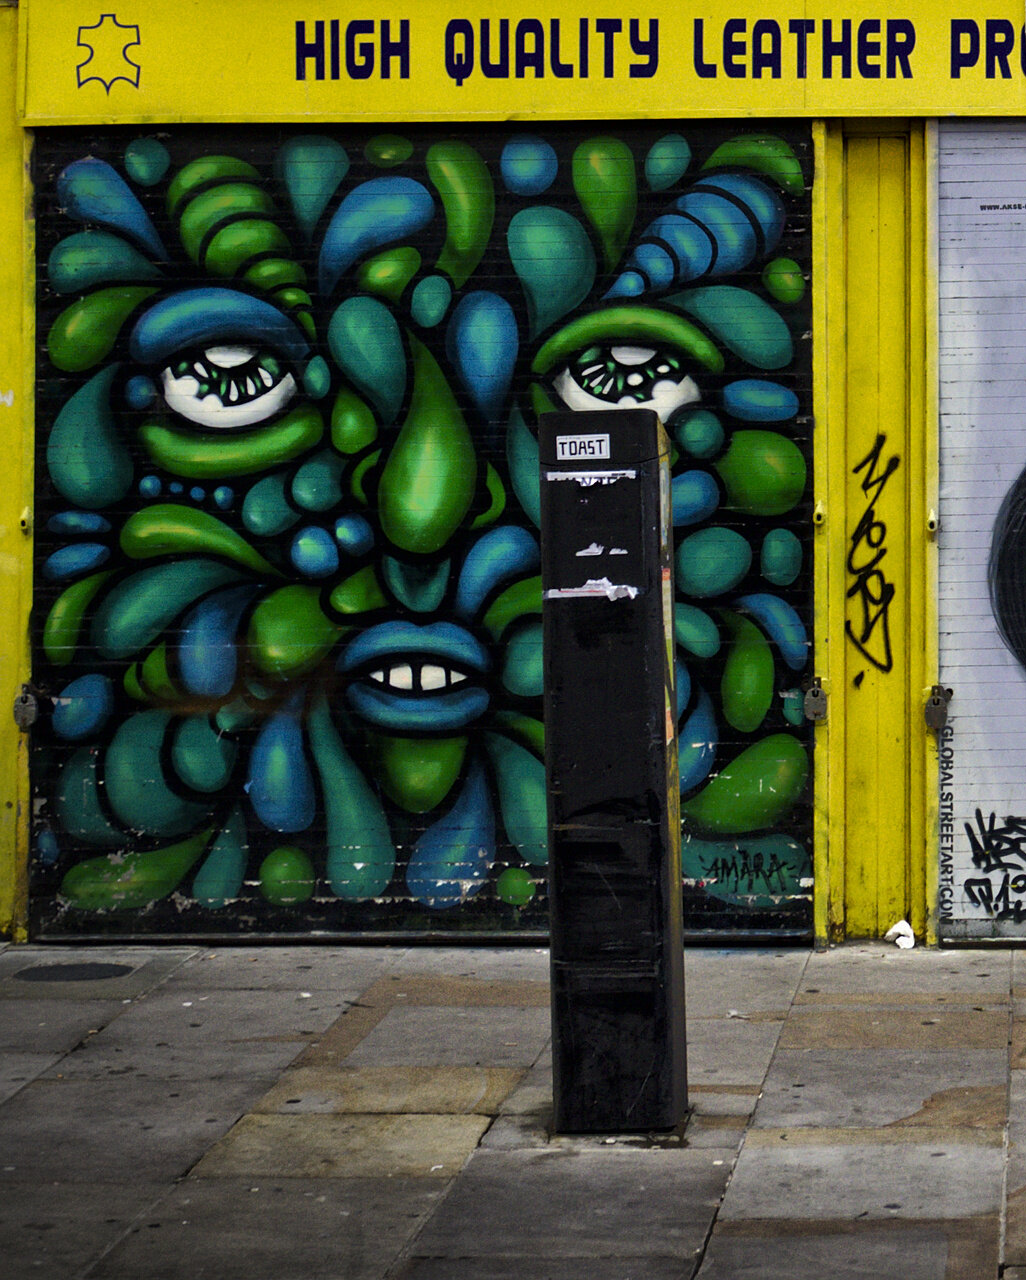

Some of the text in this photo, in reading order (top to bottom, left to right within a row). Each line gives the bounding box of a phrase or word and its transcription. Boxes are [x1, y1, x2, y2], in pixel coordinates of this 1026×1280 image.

[295, 19, 411, 81] HIGH
[444, 18, 660, 87] QUALITY
[693, 18, 917, 80] LEATHER
[558, 439, 605, 456] TOAST
